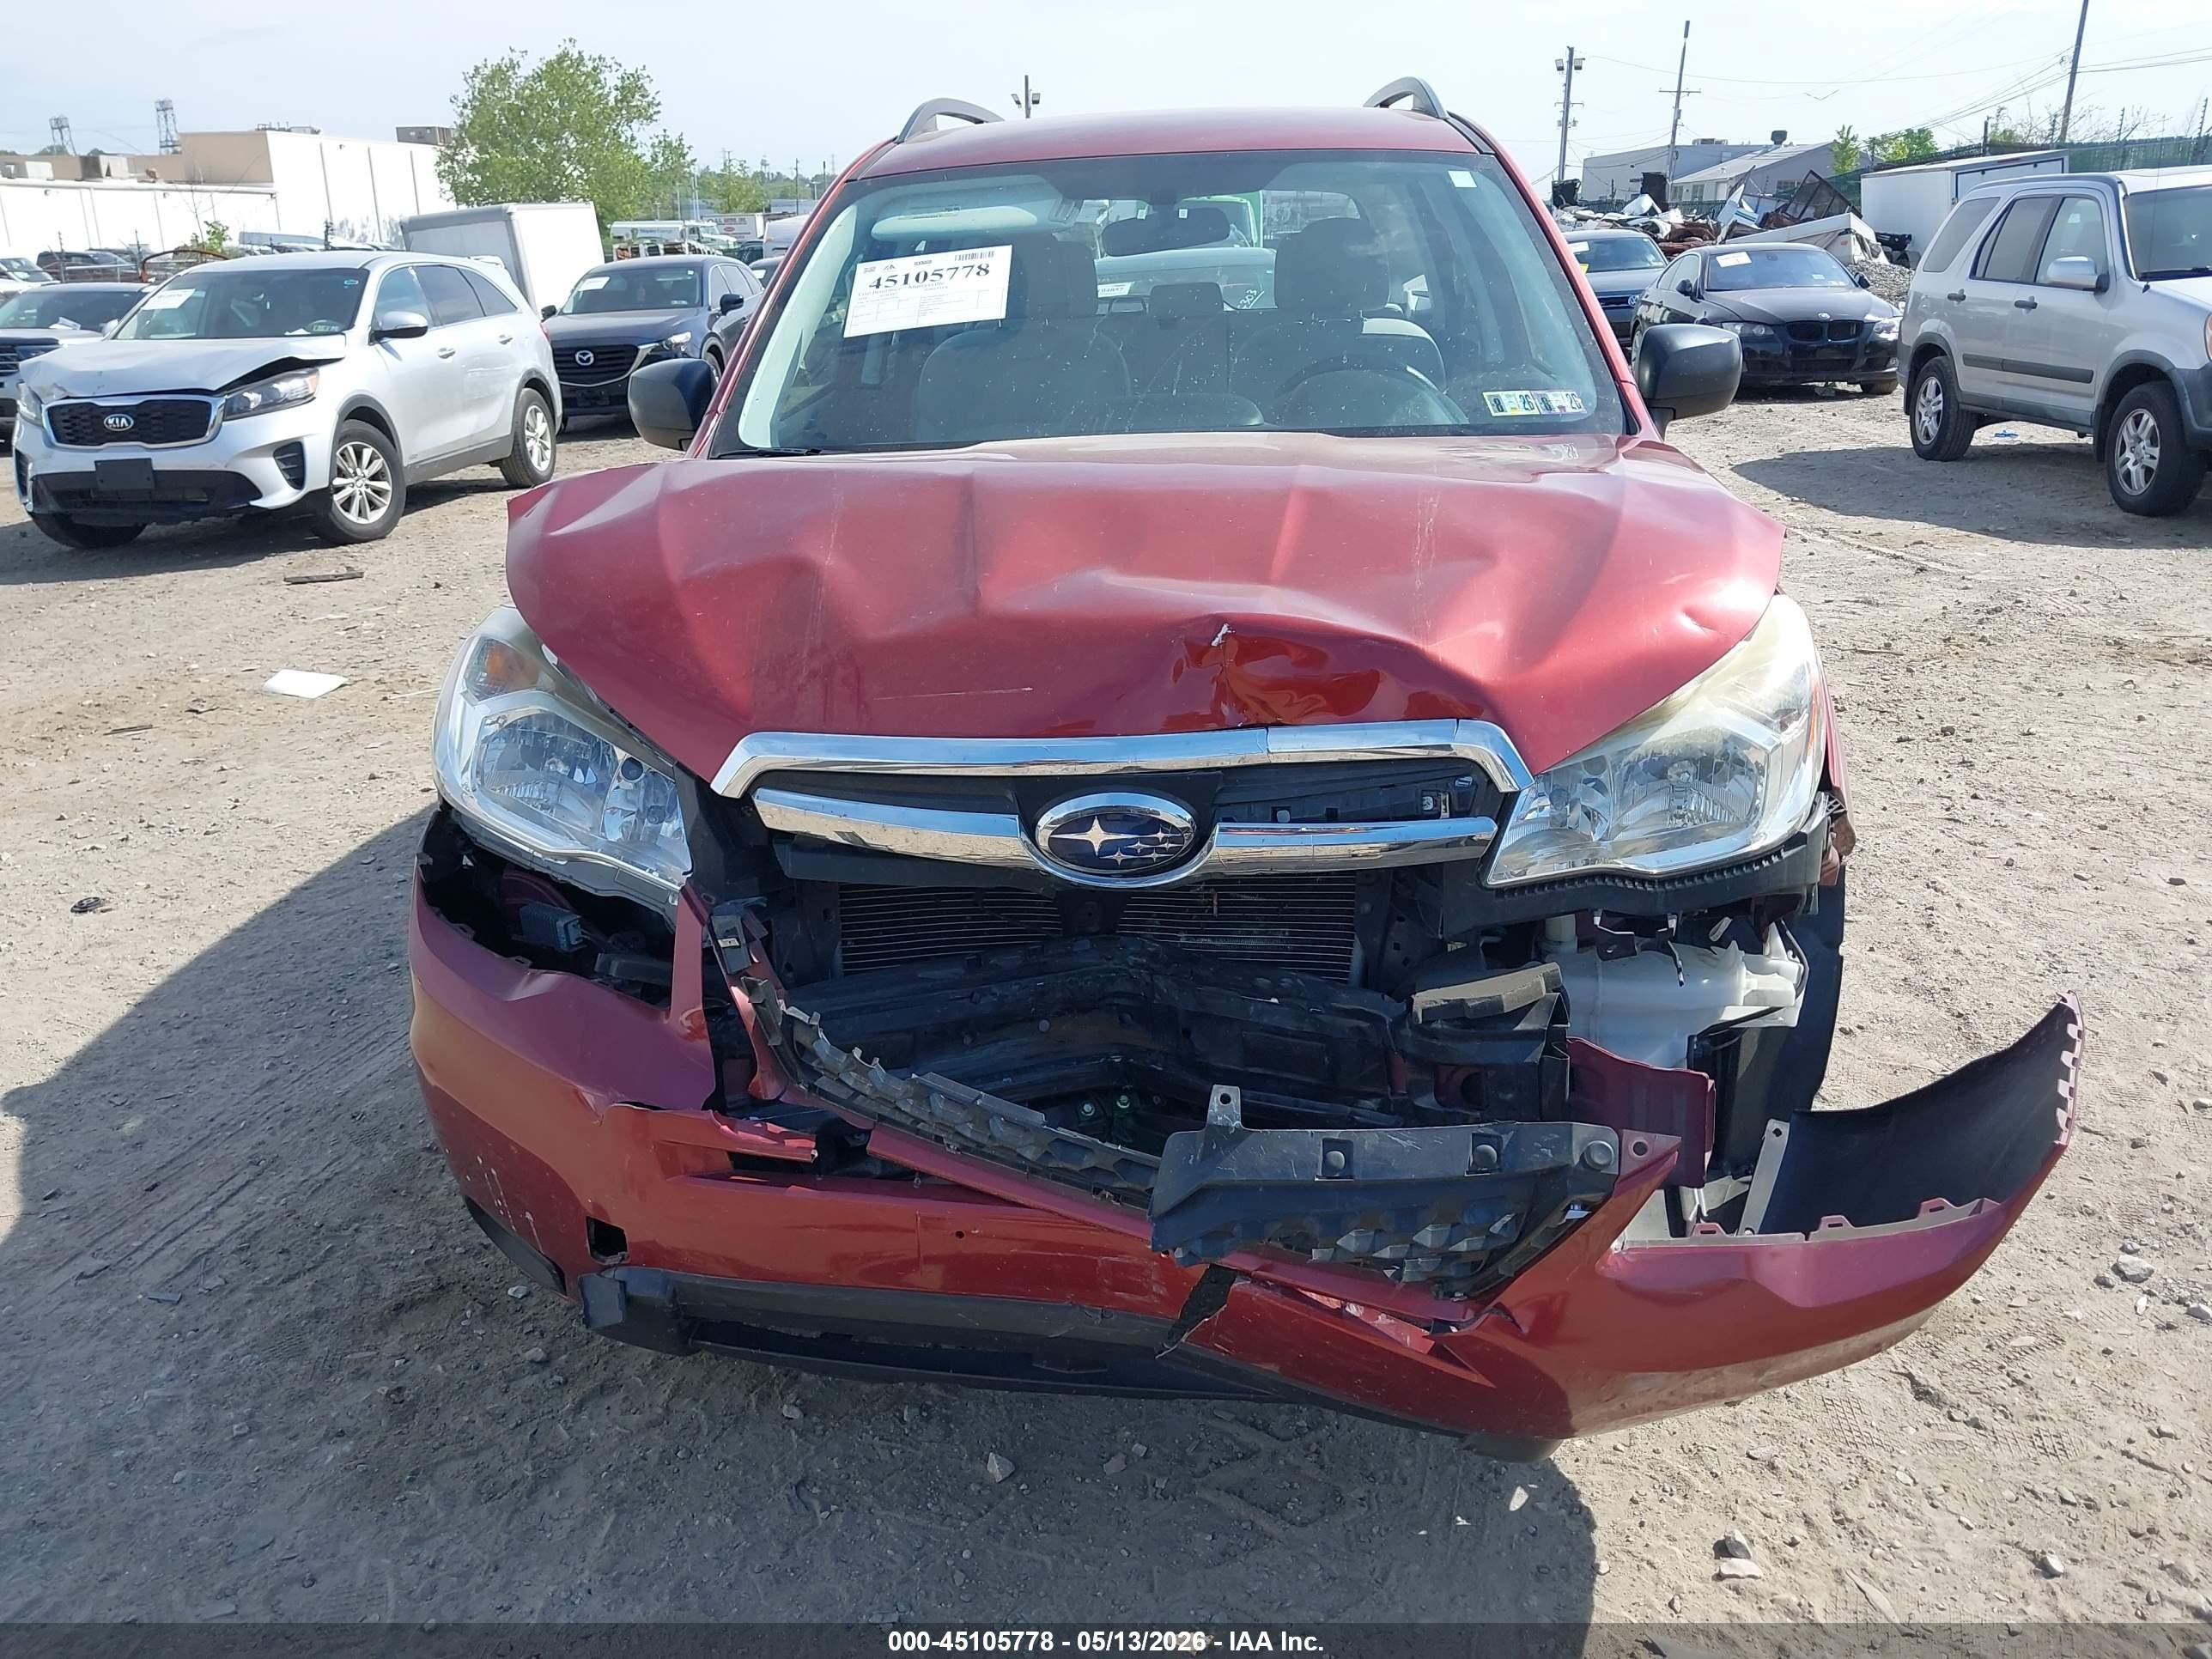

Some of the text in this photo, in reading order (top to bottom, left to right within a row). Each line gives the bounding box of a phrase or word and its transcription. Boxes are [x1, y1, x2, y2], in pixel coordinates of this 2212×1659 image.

[868, 262, 990, 289] 45105778
[1519, 394, 1535, 410] 26
[107, 417, 129, 428] KIA
